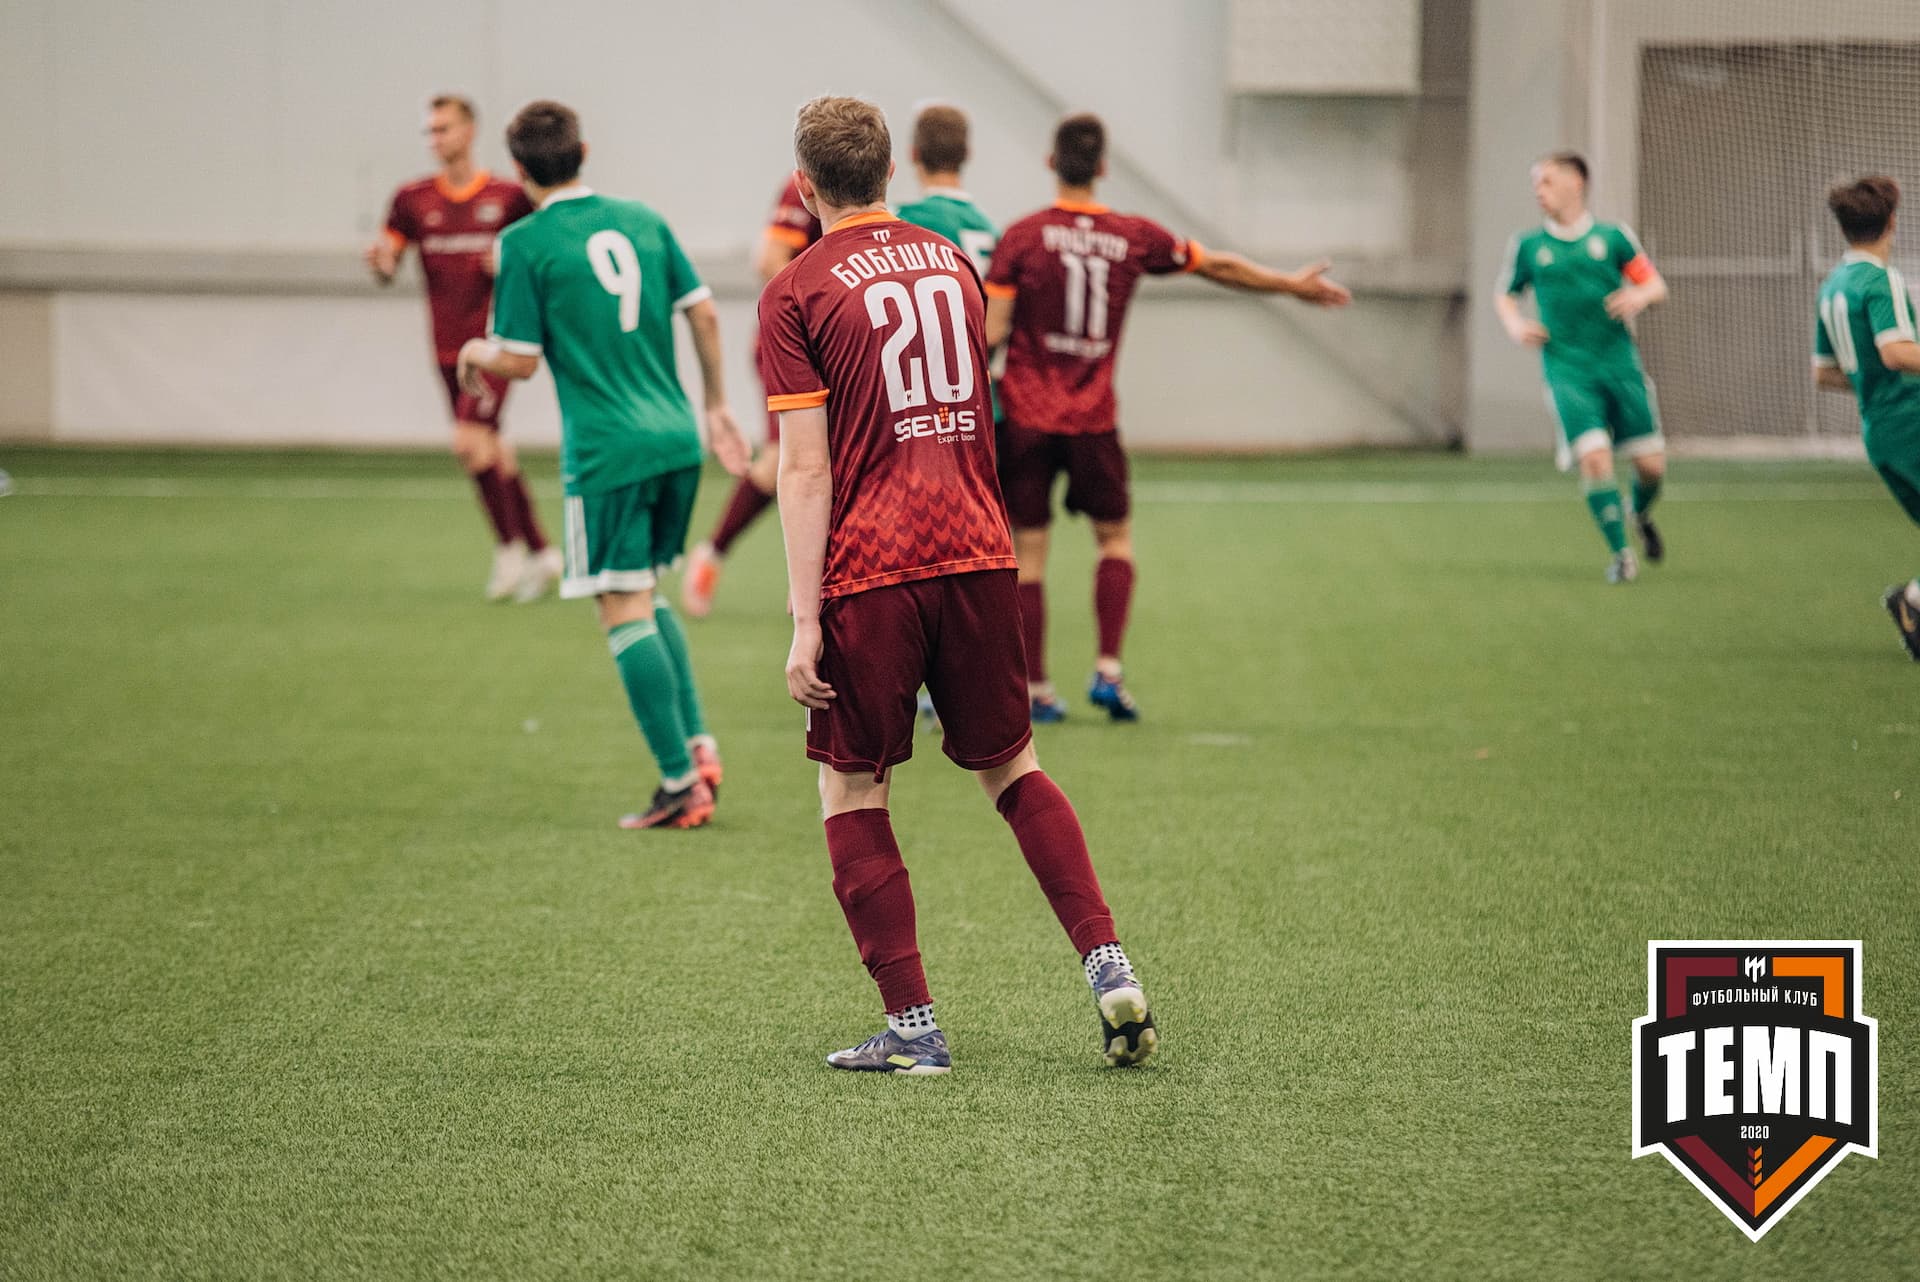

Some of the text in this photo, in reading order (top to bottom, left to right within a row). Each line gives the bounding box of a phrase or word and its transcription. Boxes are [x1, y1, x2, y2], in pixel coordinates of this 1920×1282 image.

[587, 229, 642, 333] 9
[830, 242, 960, 290] БОБЕШКО
[1060, 252, 1110, 339] 11
[864, 274, 974, 413] 20
